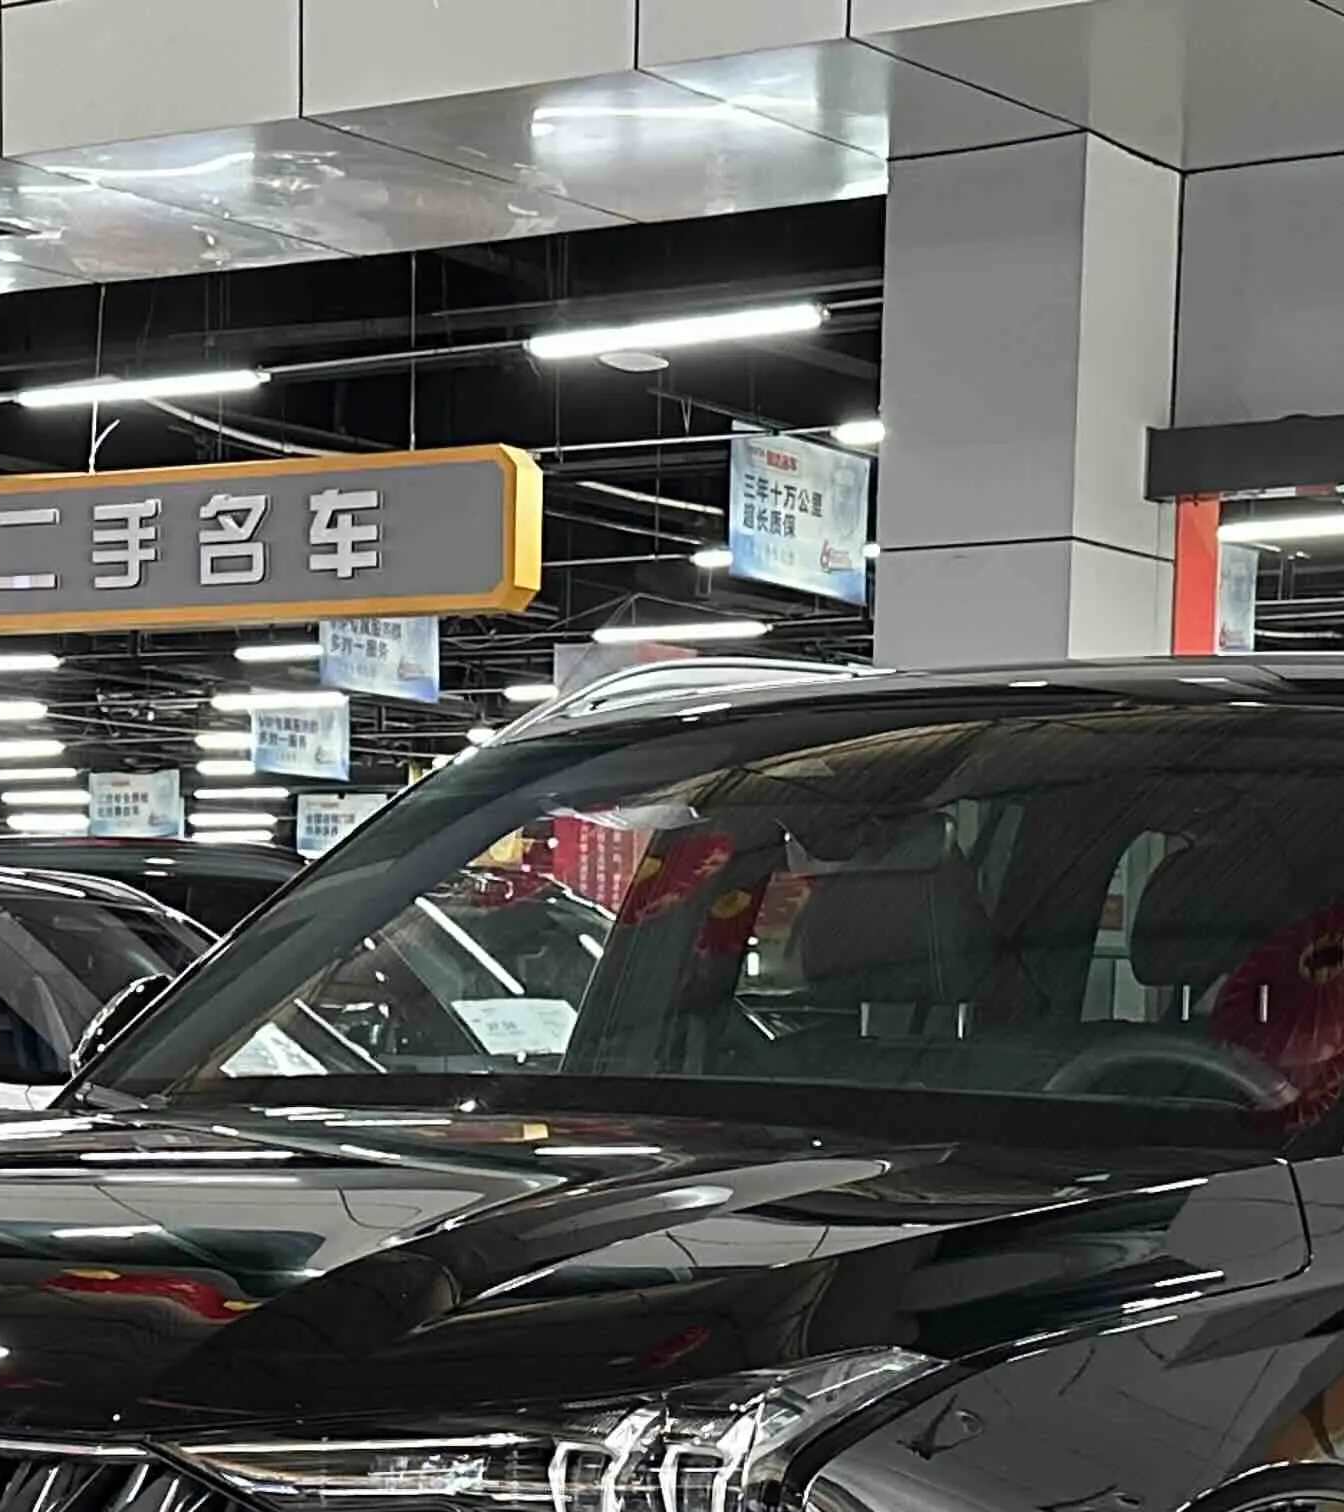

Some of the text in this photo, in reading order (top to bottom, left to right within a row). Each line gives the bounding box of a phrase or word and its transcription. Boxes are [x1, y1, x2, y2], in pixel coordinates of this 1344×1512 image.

[744, 473, 823, 518] 三年十万公里
